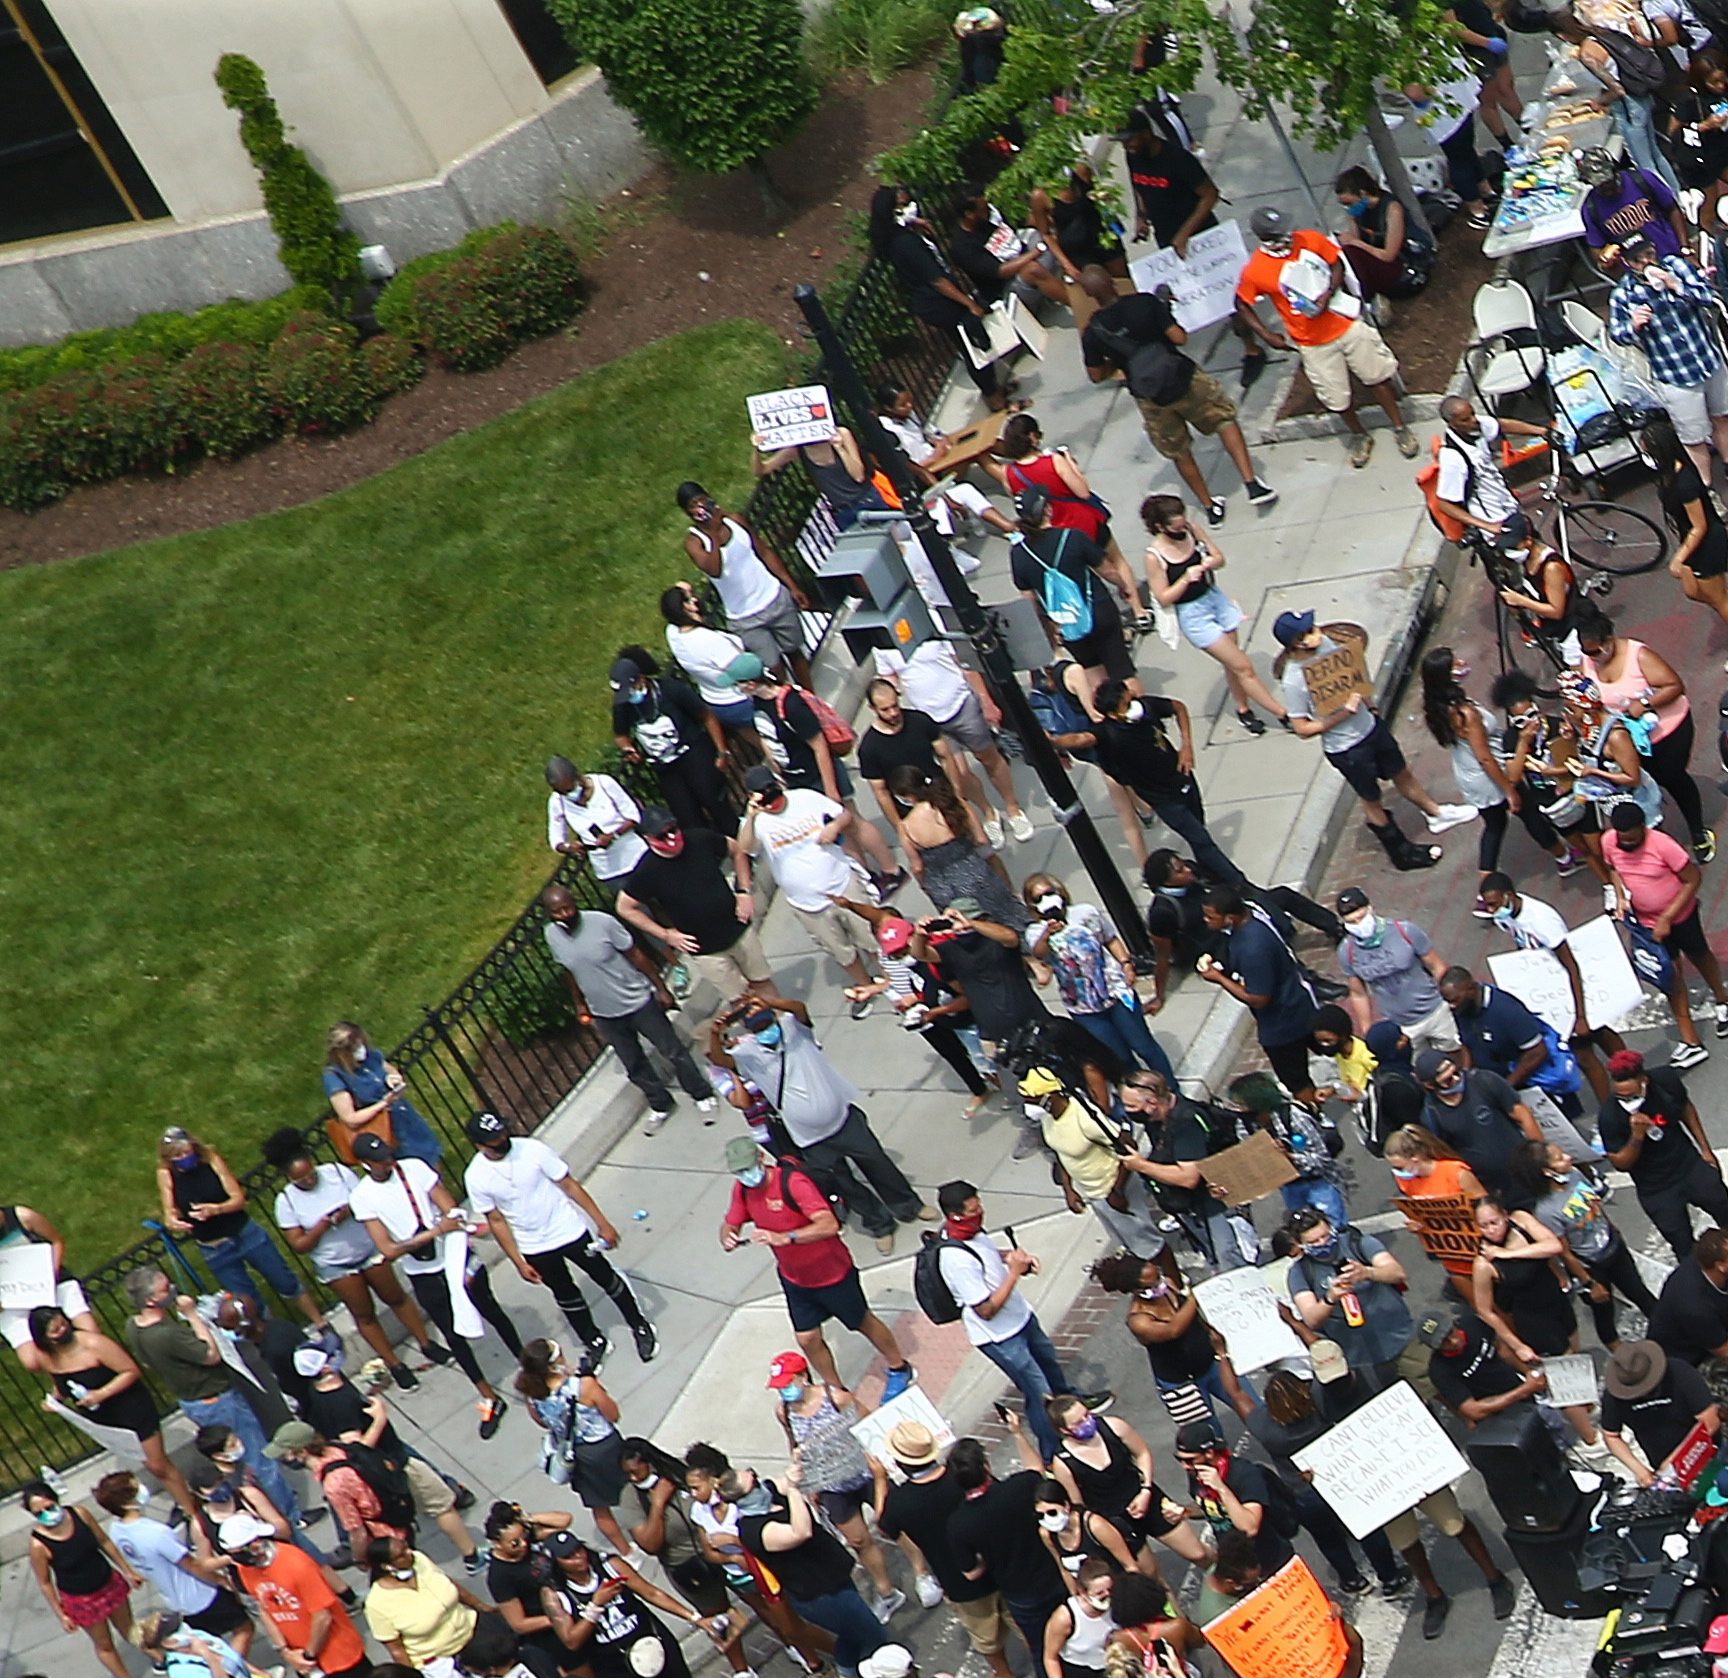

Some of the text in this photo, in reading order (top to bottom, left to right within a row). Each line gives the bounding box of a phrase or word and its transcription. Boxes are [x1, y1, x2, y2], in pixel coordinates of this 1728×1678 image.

[1145, 251, 1178, 277] YOU
[752, 390, 812, 413] BLACK
[754, 405, 812, 429] LIVES
[1305, 650, 1355, 684] DEFUND
[1309, 669, 1363, 702] DISARM
[1428, 1215, 1479, 1235] OUT
[1428, 1231, 1491, 1251] NOW
[859, 1396, 932, 1444] BLM
[1355, 1384, 1414, 1431] BELIEVE
[1314, 1408, 1418, 1487] WHAT YOU SAY
[1327, 1447, 1399, 1503] BECAUSE
[1406, 1417, 1441, 1448] SEE
[1352, 1456, 1419, 1510] WHAT YOU
